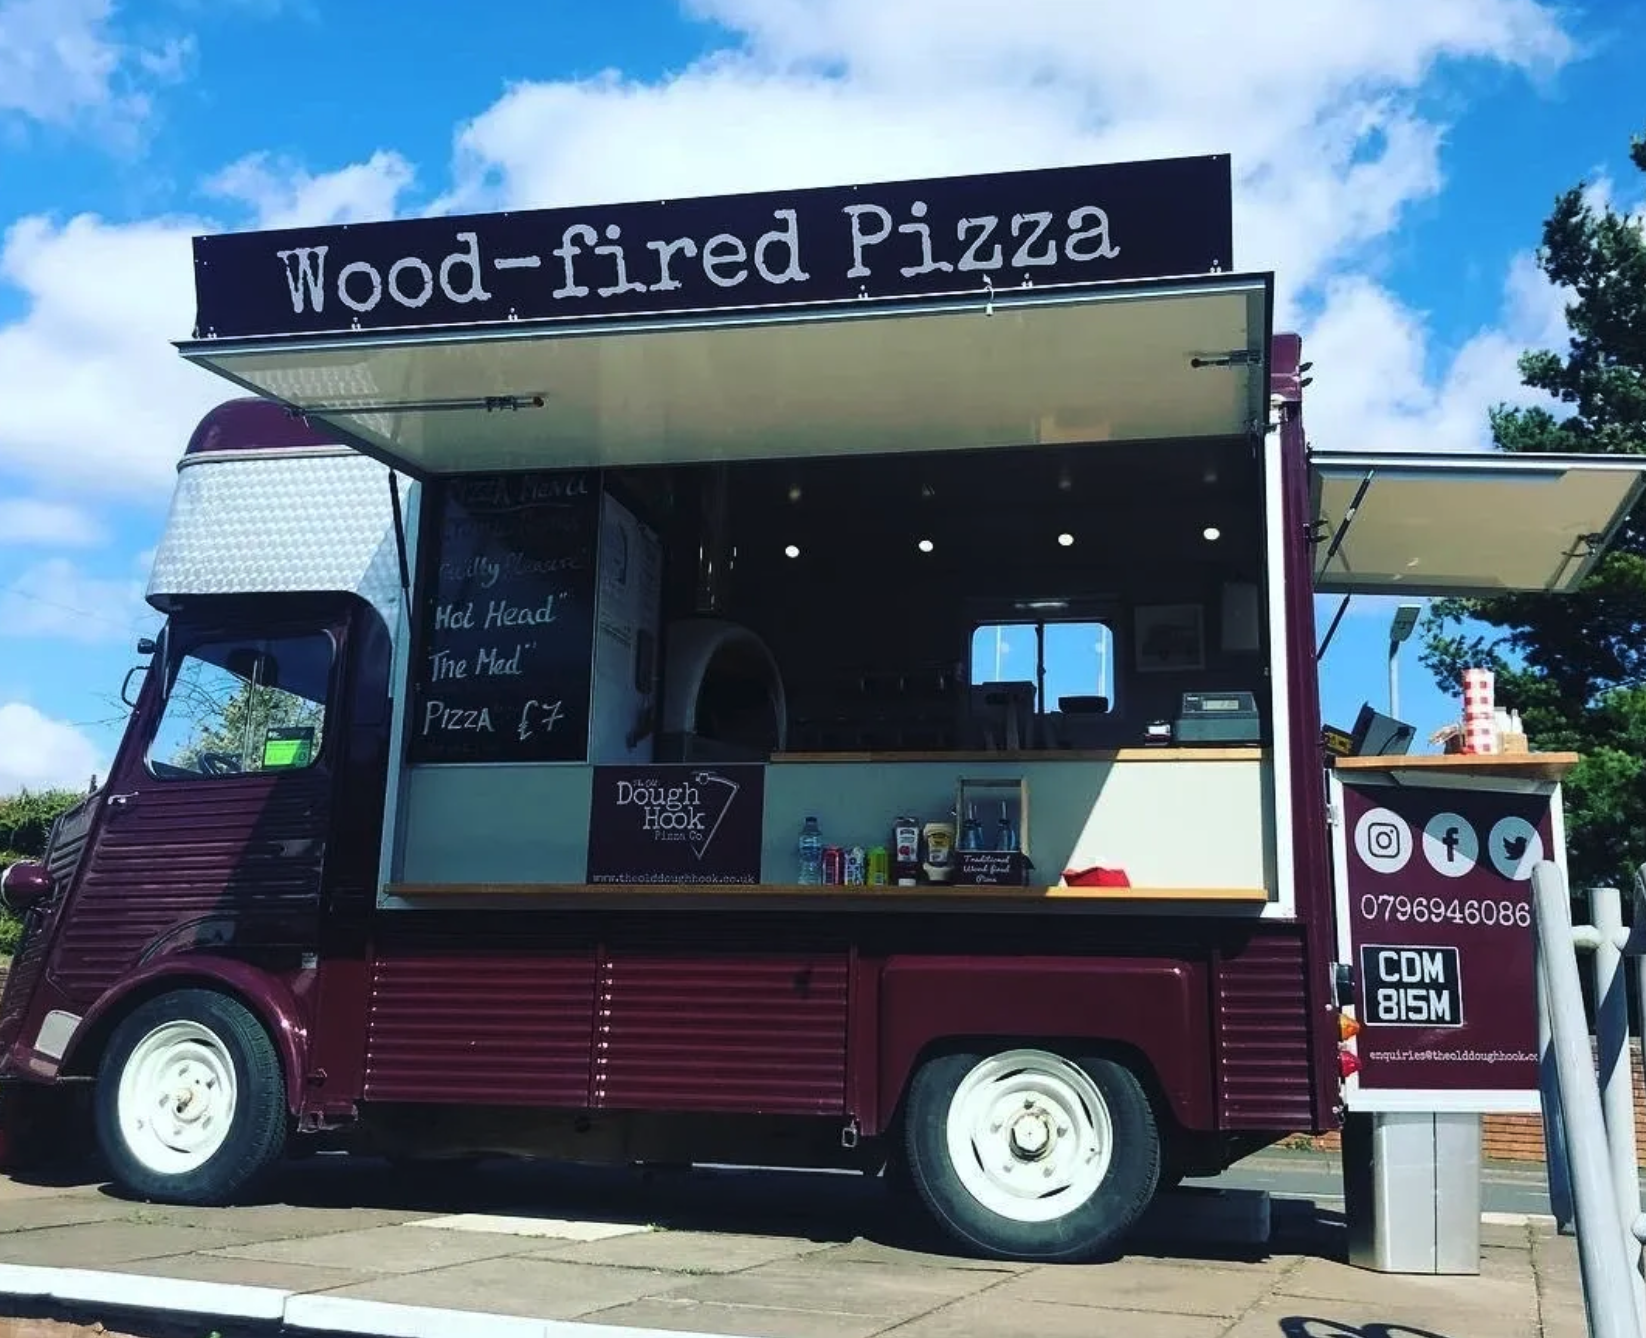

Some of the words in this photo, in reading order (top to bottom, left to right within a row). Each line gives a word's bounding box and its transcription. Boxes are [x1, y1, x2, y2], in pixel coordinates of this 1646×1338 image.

[276, 208, 810, 314] Wood-fired
[844, 200, 1121, 279] Pizza
[517, 699, 567, 741] £7
[616, 780, 701, 811] Dough
[642, 805, 706, 830] Hook
[654, 830, 686, 841] Pizza
[593, 873, 756, 884] www.theolddoughhook.co.uk
[1378, 950, 1445, 983] CDM
[1377, 988, 1451, 1022] 815M
